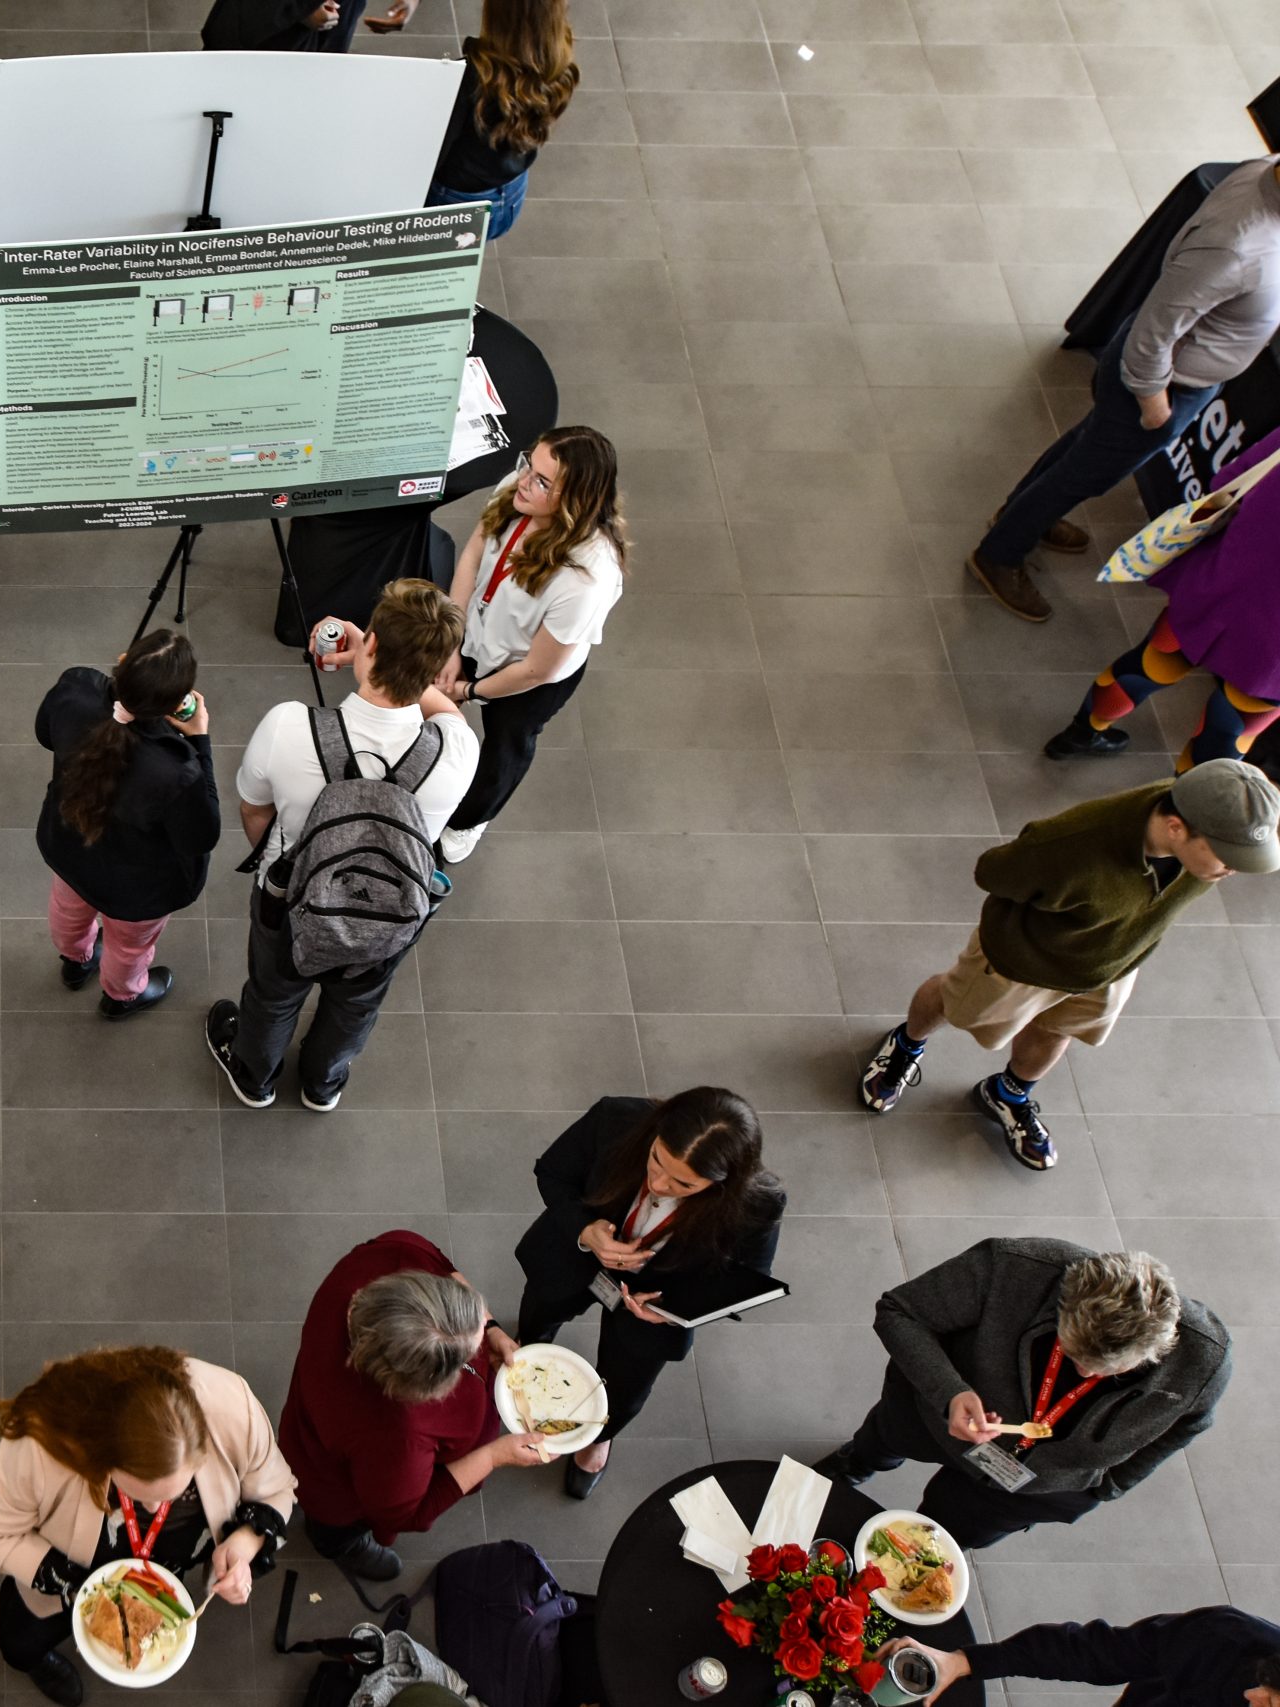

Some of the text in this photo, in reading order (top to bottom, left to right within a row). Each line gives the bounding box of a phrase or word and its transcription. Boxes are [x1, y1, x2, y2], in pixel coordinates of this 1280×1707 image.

[4, 213, 472, 263] Inter-Rater Variability in Nocifensive Behaviour Testing of Rodents
[22, 230, 452, 275] Emma-Lee Procher, Elaine Marshall, Emma Bondar, Annemarie Dedek, Mike Hildebrand
[130, 255, 348, 280] Faculty of Science, Department of Neuroscience
[337, 269, 370, 279] Results
[331, 321, 379, 332] Discussion
[1194, 400, 1246, 474] et
[186, 494, 234, 503] Undergraduate
[292, 489, 343, 500] Carleton
